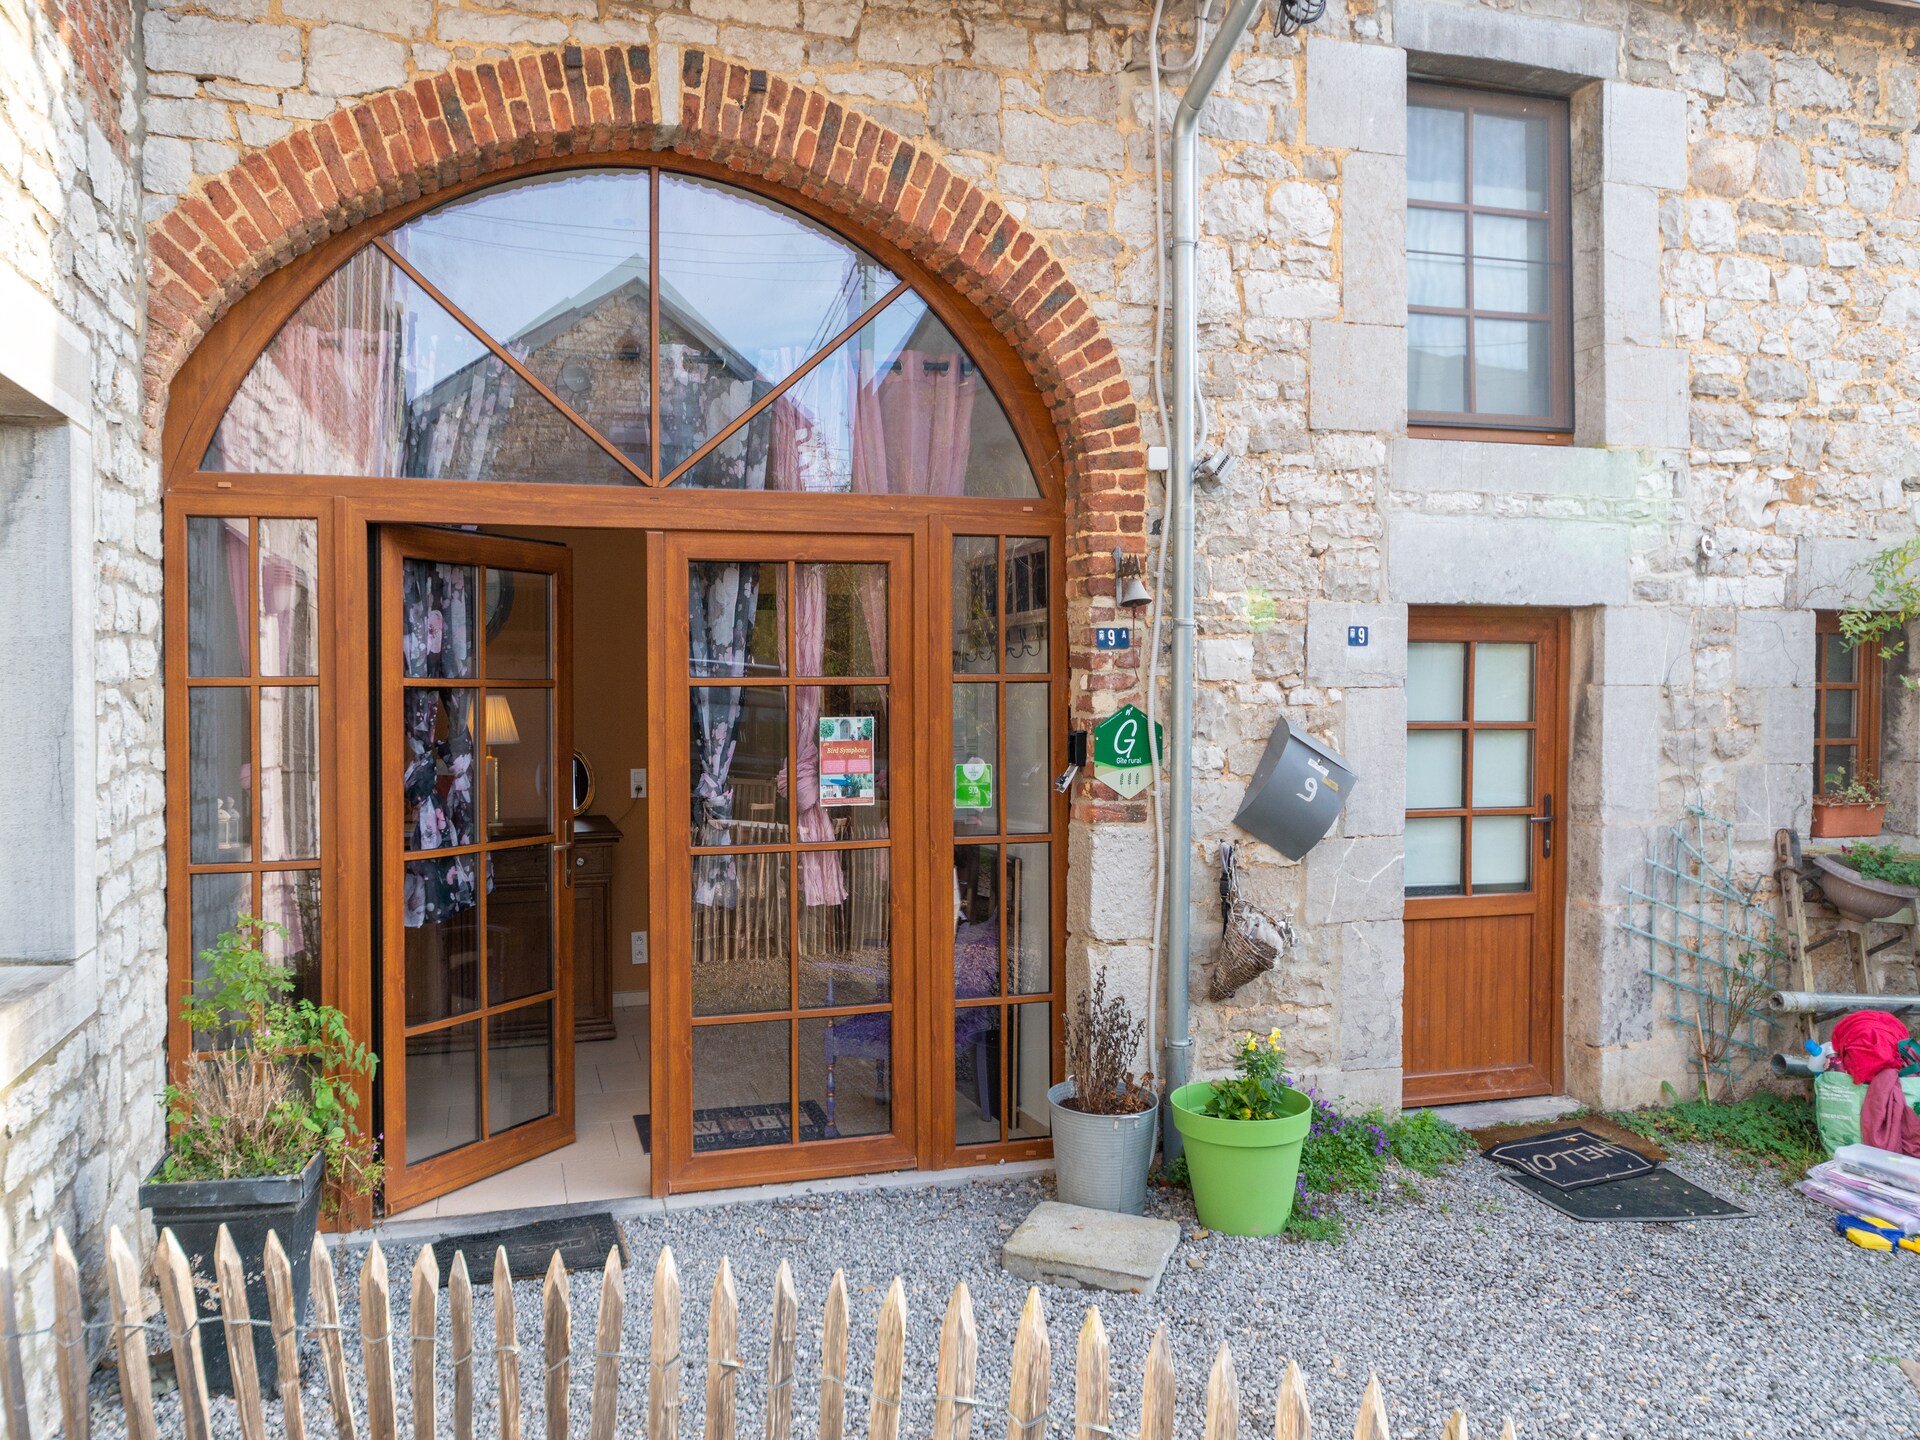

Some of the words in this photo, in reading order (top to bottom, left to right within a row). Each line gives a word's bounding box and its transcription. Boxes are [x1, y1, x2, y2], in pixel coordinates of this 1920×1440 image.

[1107, 629, 1116, 646] 9
[1358, 628, 1365, 643] 9
[1113, 719, 1137, 758] G
[1296, 777, 1318, 802] 9
